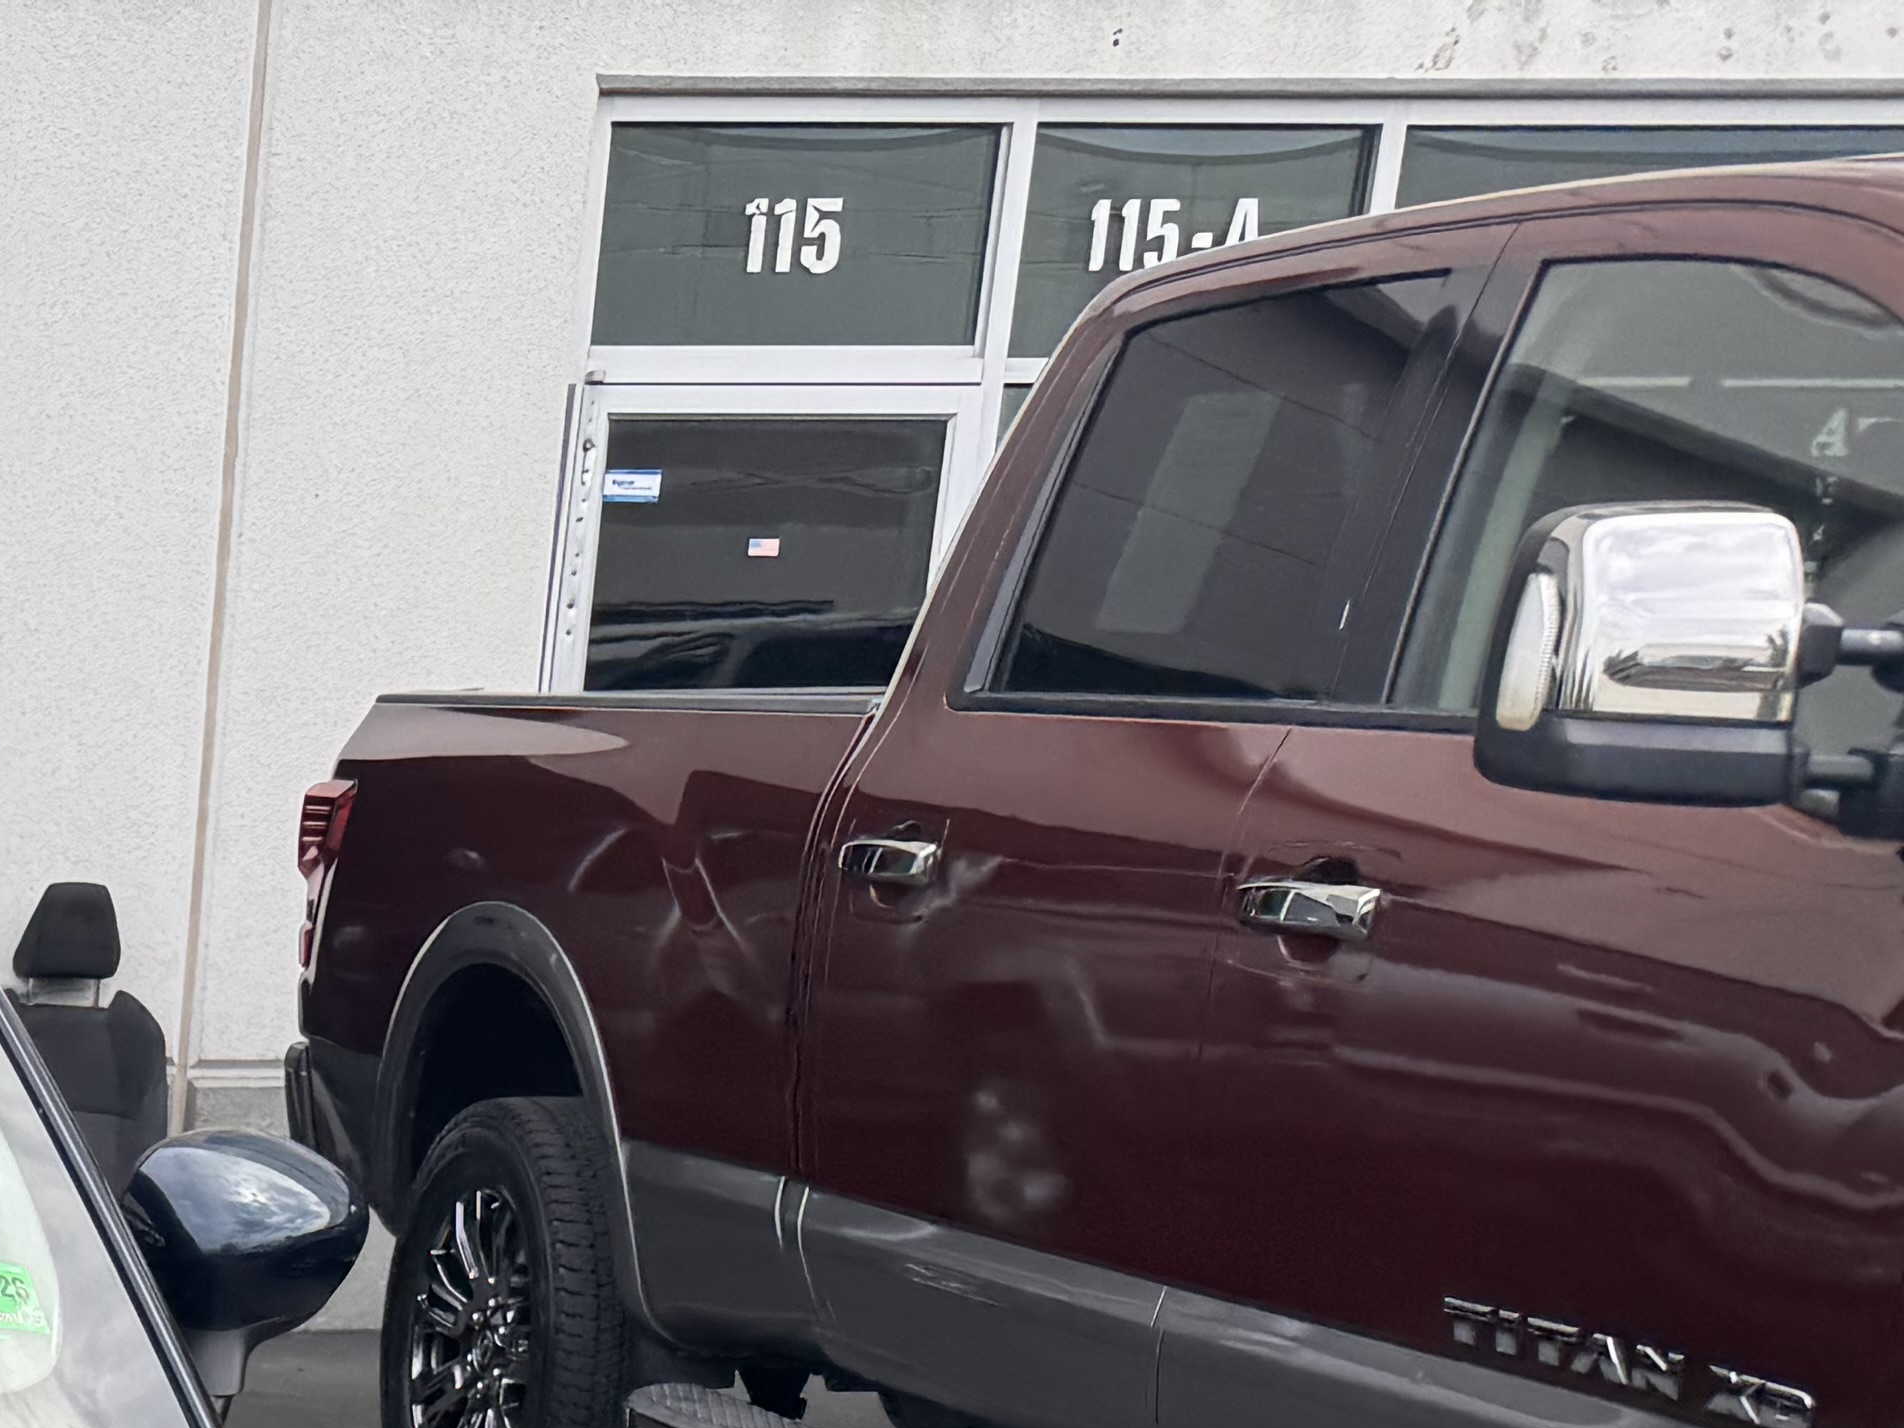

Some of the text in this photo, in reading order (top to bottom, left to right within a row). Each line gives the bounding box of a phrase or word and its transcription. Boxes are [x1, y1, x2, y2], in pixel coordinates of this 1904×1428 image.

[744, 196, 844, 274] 115
[1088, 196, 1260, 273] 115-A
[1443, 1295, 1685, 1402] TITAN
